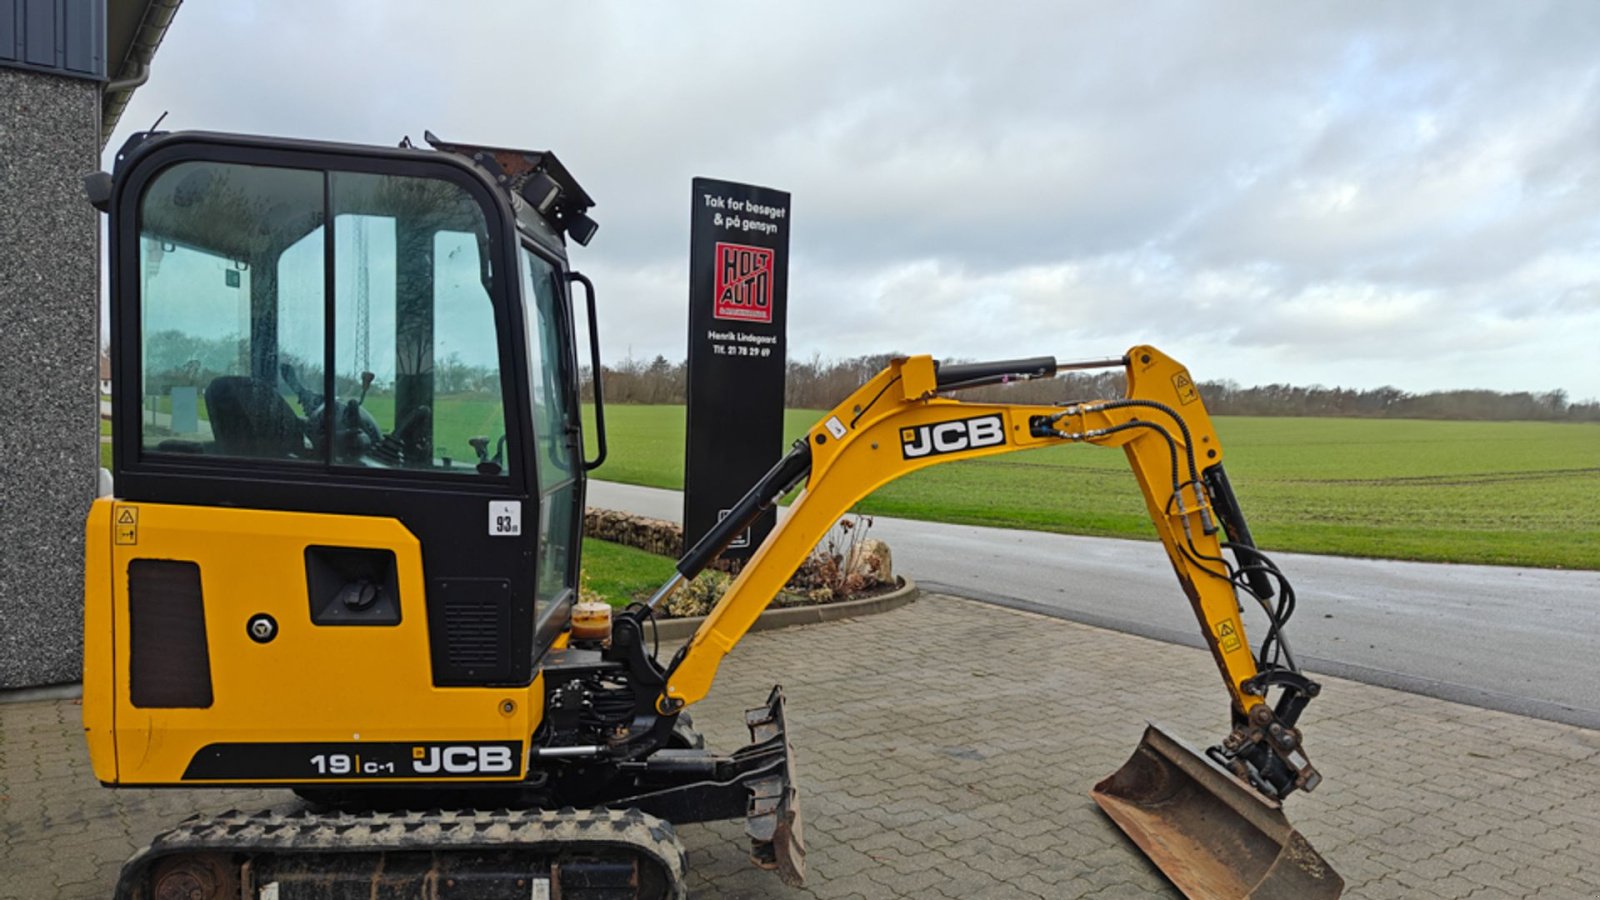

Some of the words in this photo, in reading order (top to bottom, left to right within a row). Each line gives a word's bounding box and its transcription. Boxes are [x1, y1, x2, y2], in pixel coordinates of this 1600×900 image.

[704, 194, 725, 208] Tak
[727, 197, 744, 211] for
[746, 200, 786, 219] besøget
[713, 213, 723, 226] &
[725, 215, 740, 230] på
[742, 219, 777, 235] gensyn
[723, 247, 769, 286] HOLT
[720, 269, 768, 307] AUTO
[707, 330, 735, 341] Henrik
[902, 416, 1004, 457] JCB
[496, 515, 511, 533] 93
[310, 754, 351, 774] 19
[412, 746, 513, 773] JCB
